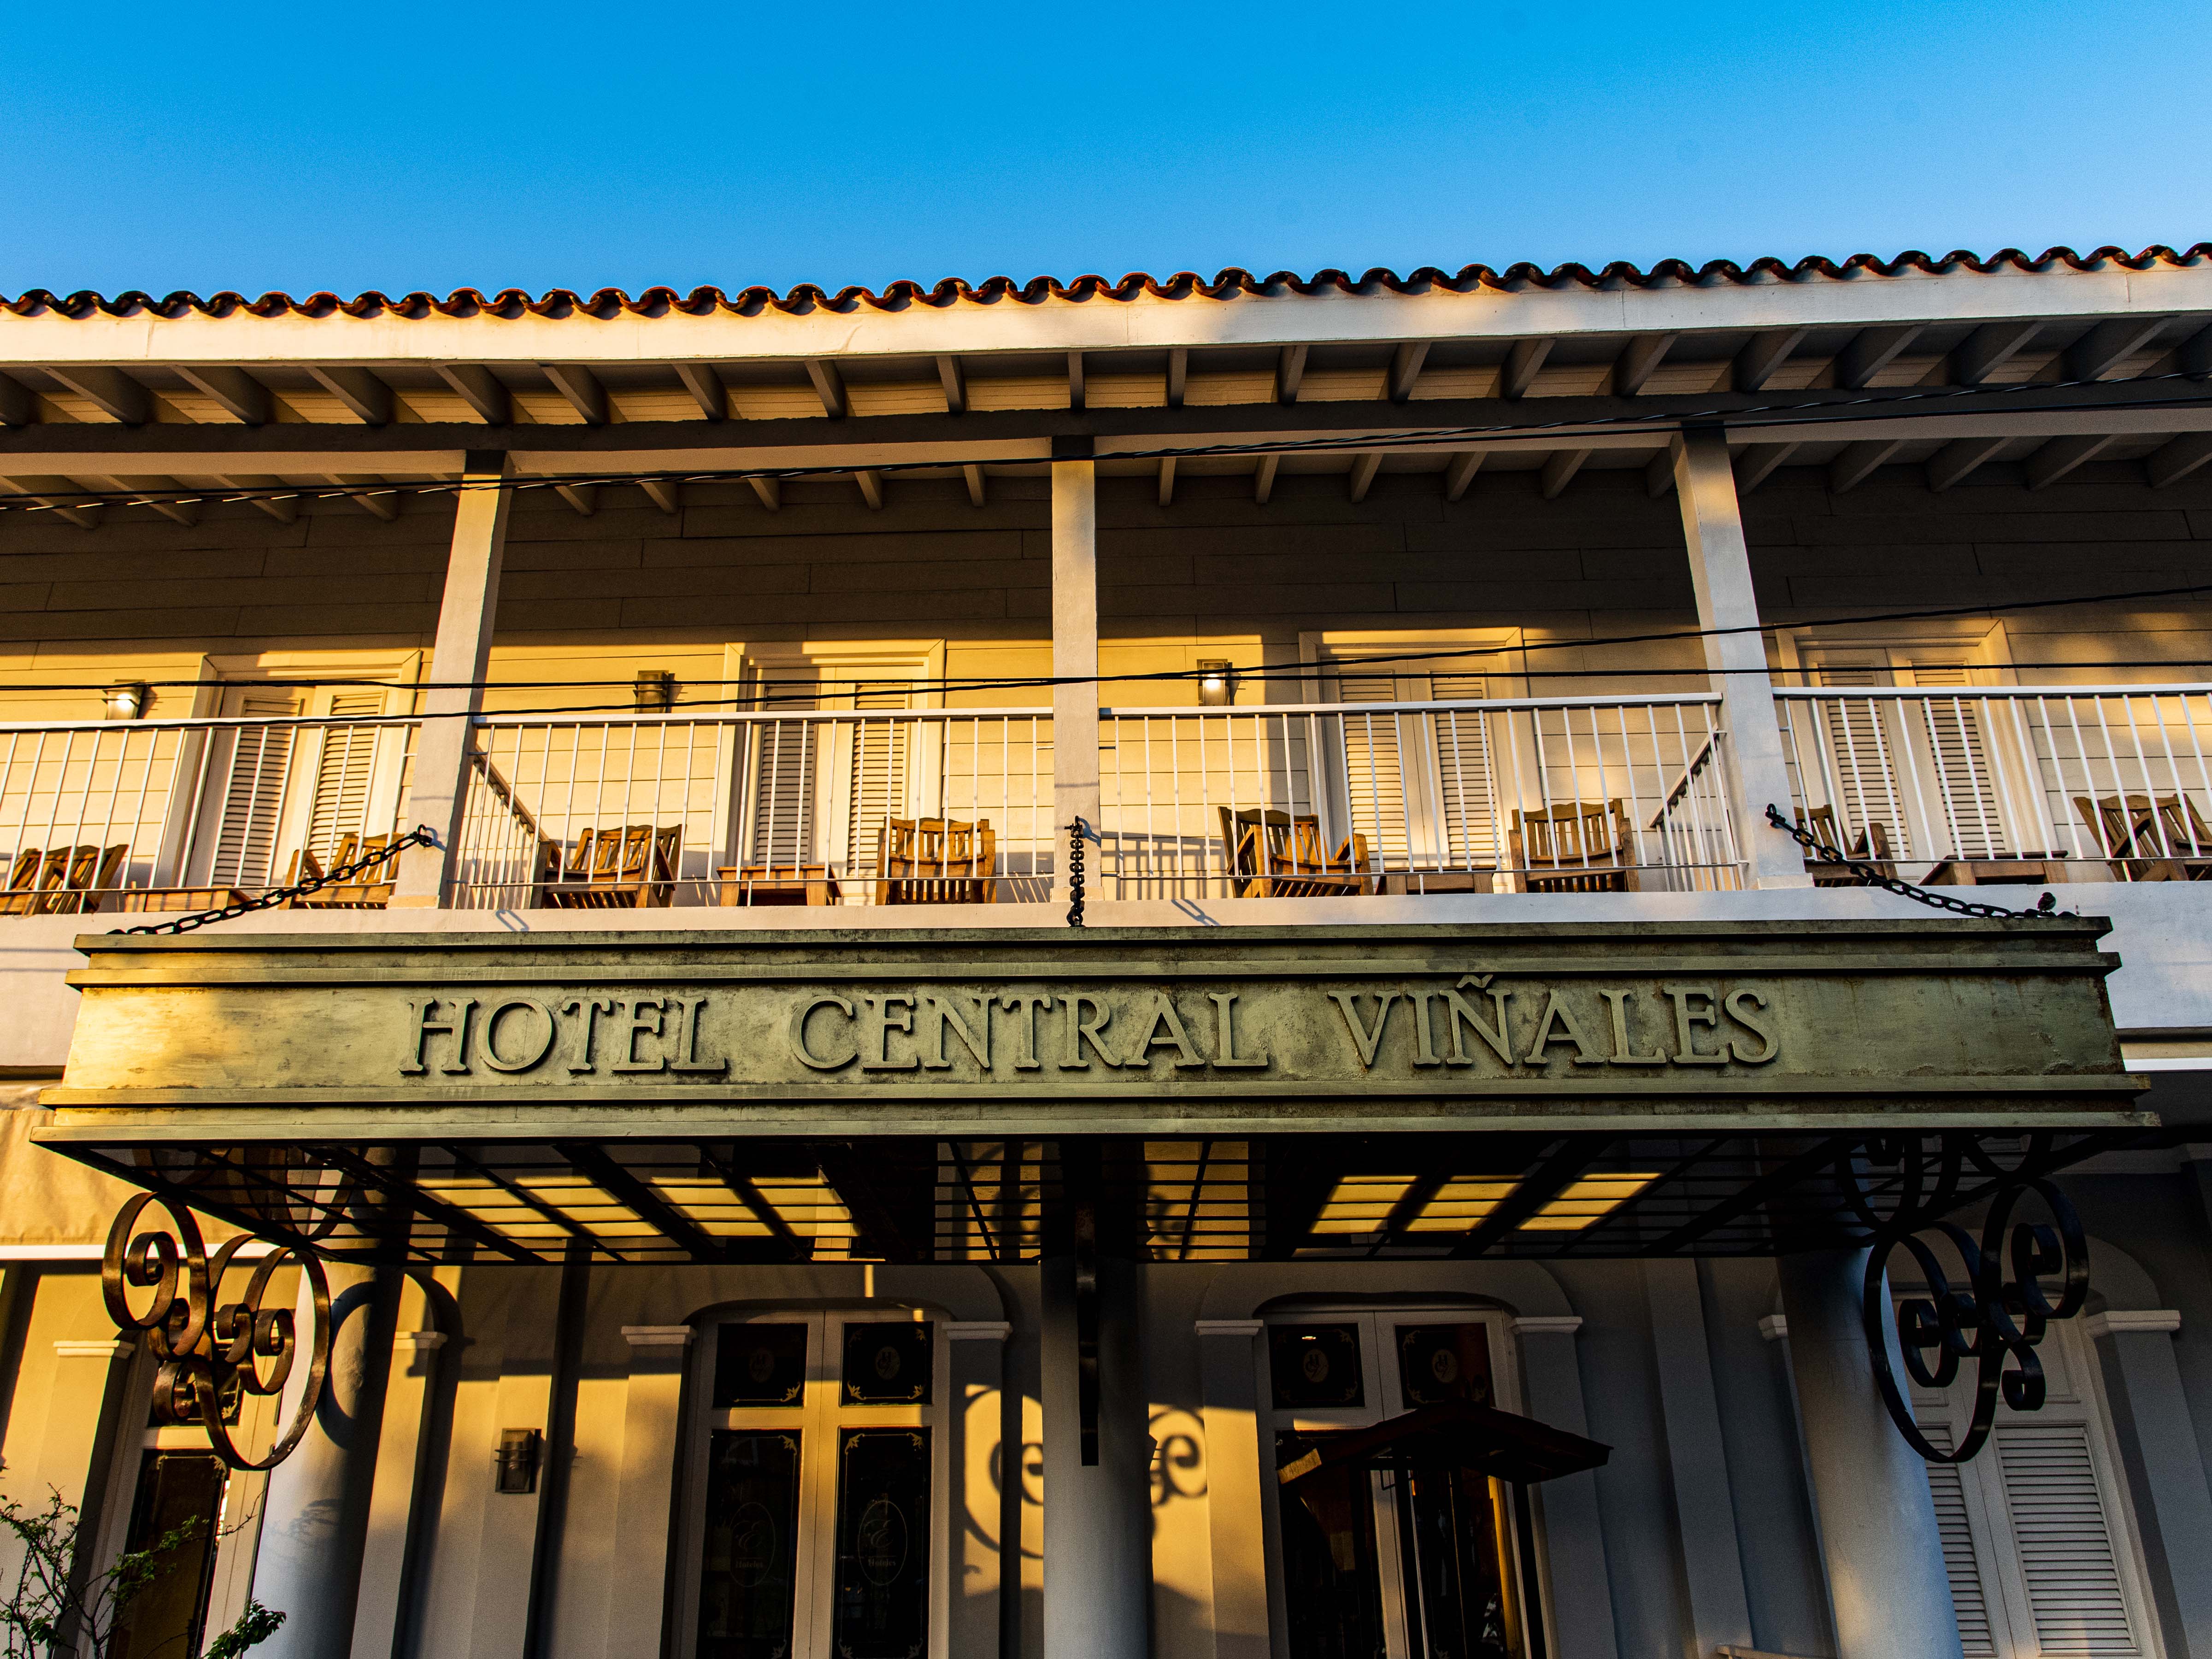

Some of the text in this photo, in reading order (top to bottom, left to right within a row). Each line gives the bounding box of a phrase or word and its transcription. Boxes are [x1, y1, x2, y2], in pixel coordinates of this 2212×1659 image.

[398, 974, 1780, 1075] HOTEL CENTRAL VIÑALES
